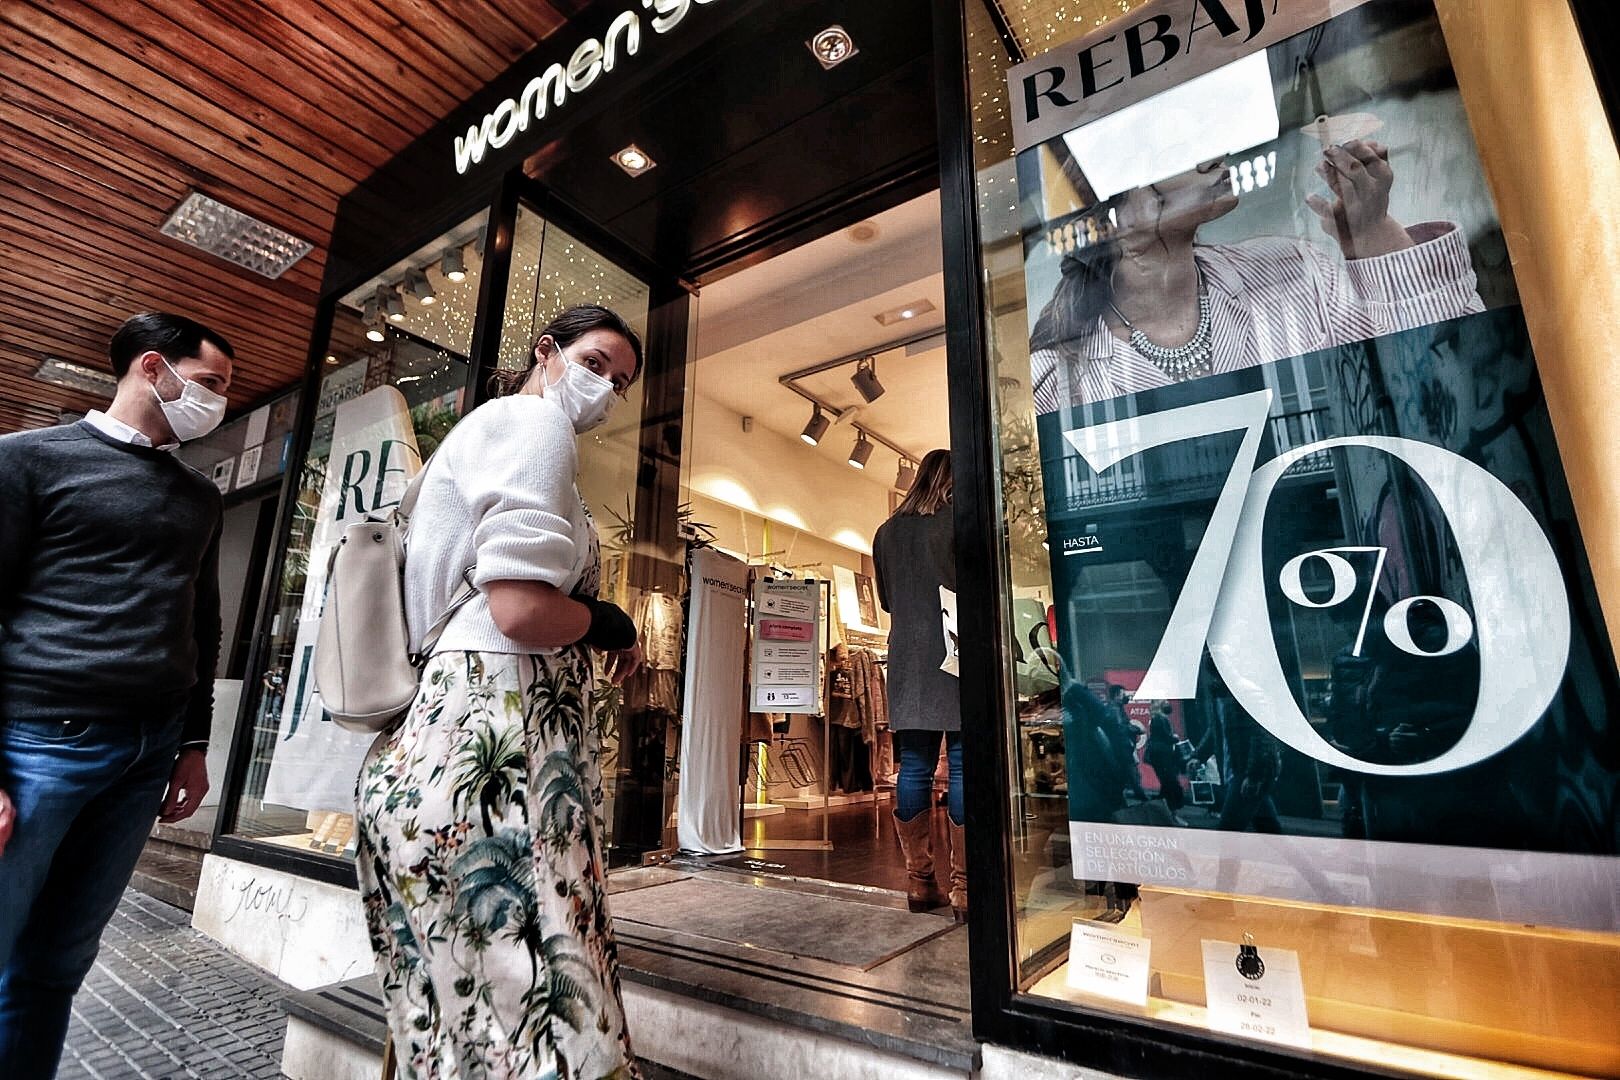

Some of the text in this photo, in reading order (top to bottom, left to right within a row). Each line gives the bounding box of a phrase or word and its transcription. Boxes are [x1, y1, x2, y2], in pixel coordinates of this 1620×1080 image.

[1022, 0, 1279, 124] REBAJ
[1063, 534, 1100, 550] HASTA
[1084, 831, 1178, 849] EN UNA GRAN
[1085, 846, 1166, 863] SELECCIÓN
[1088, 861, 1105, 873] DE
